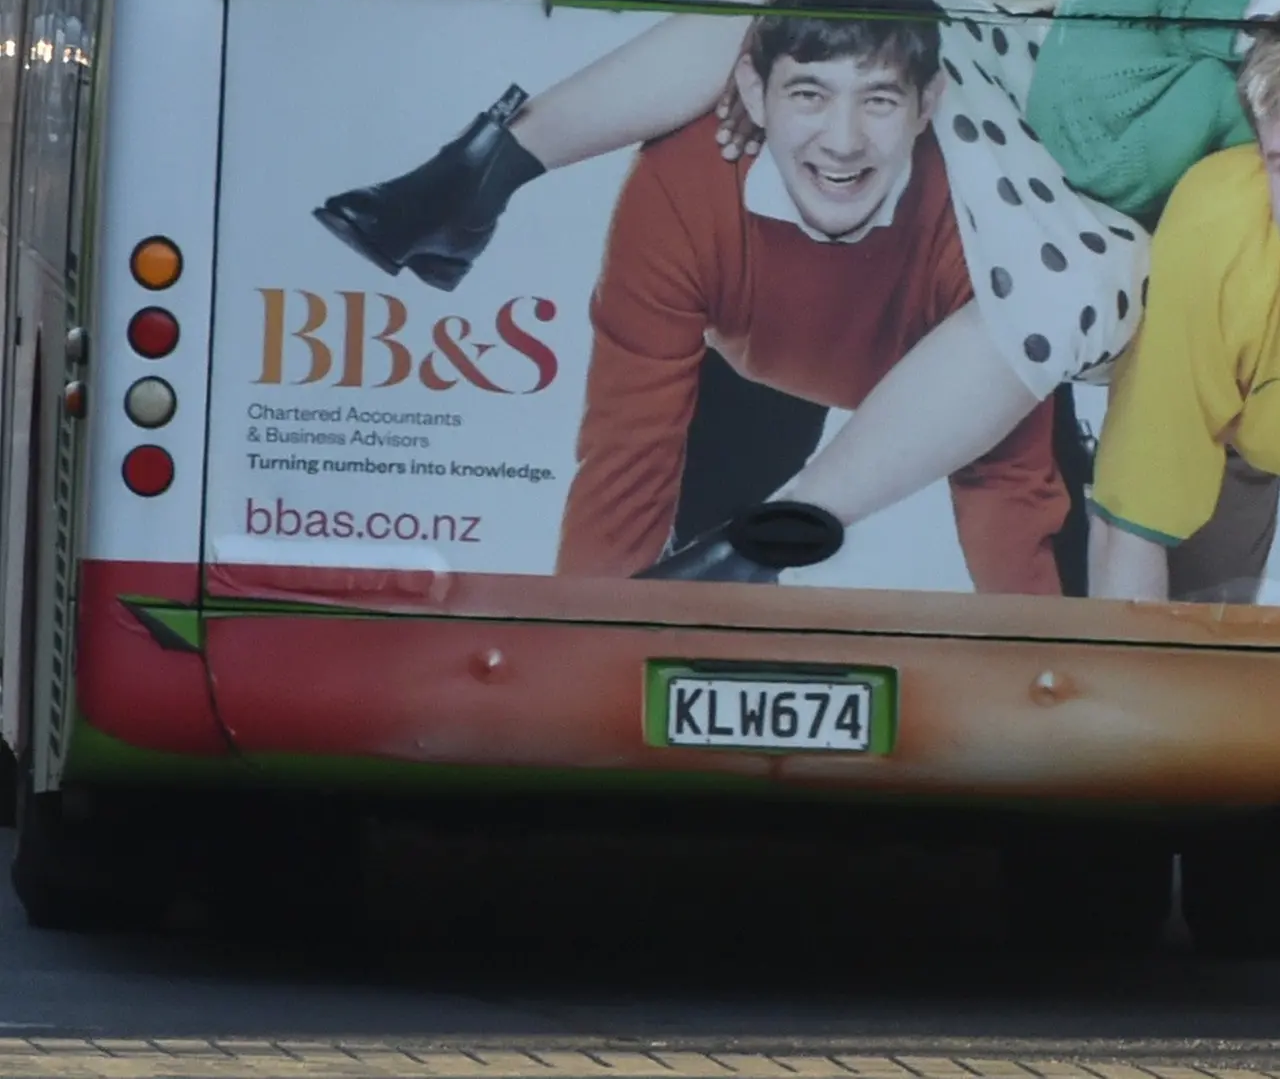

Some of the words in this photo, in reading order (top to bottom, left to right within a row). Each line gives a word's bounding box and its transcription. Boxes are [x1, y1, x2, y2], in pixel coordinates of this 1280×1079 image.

[254, 287, 558, 395] BB&S
[247, 403, 341, 422] Chartered
[346, 405, 463, 427] Accountants
[246, 426, 261, 444] &
[266, 427, 346, 446] Business
[350, 429, 430, 448] Advisors
[246, 453, 318, 475] Turning
[322, 457, 406, 476] numbers
[410, 459, 447, 476] into
[450, 461, 556, 483] knowledge.
[245, 497, 482, 543] bbas.co.nz
[673, 687, 863, 742] KLW674
